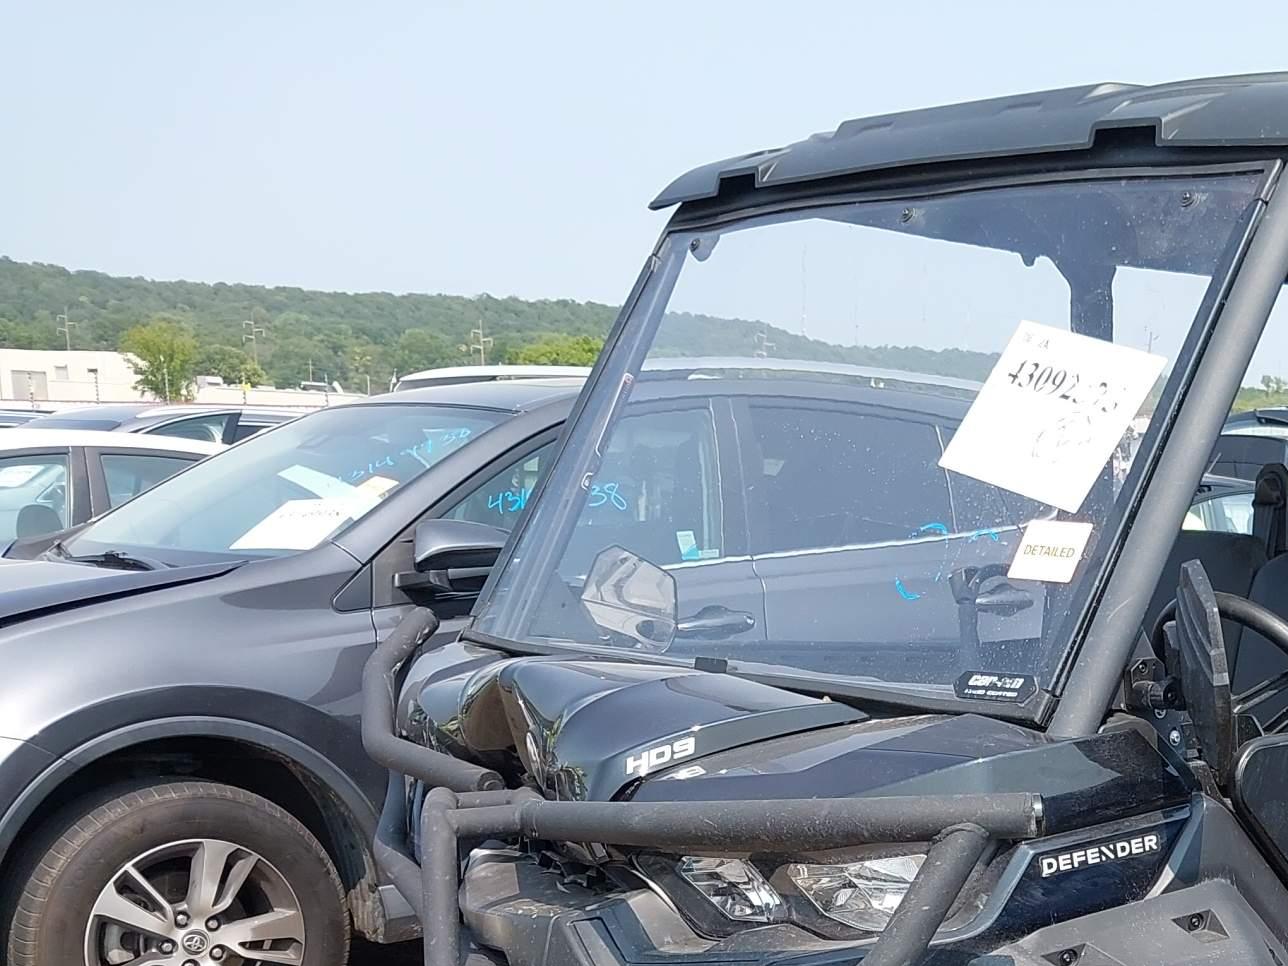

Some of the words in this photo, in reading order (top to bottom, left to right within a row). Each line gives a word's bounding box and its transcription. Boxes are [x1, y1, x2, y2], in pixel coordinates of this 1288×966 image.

[1024, 544, 1076, 558] DETAILED
[626, 737, 696, 776] HD9
[1041, 834, 1158, 878] DEFENDER
